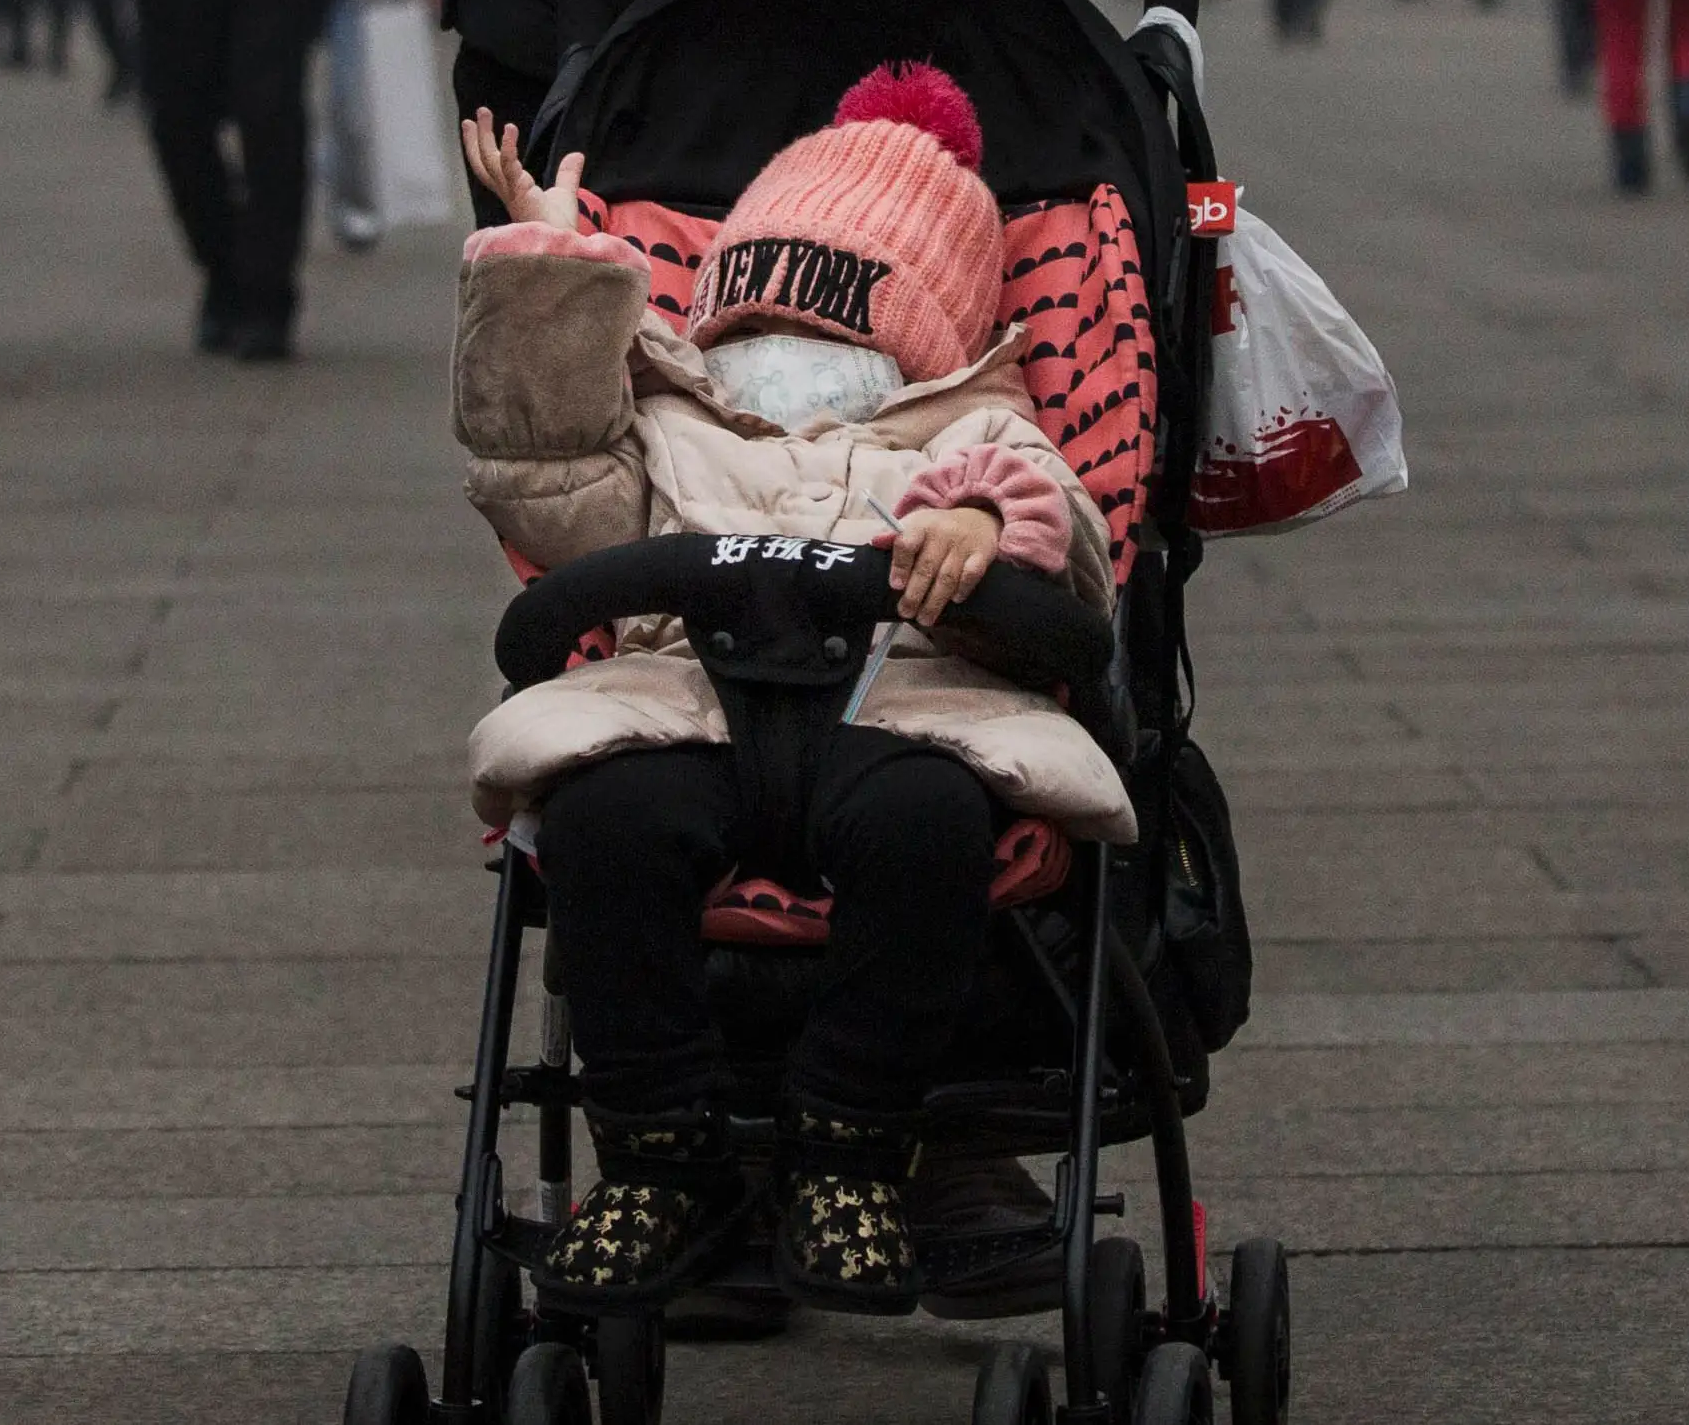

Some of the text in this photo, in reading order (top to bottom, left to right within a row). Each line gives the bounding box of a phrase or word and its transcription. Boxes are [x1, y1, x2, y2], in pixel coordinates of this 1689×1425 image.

[1188, 197, 1227, 230] gb
[774, 238, 893, 335] YORK
[711, 535, 856, 571] 好孩子
